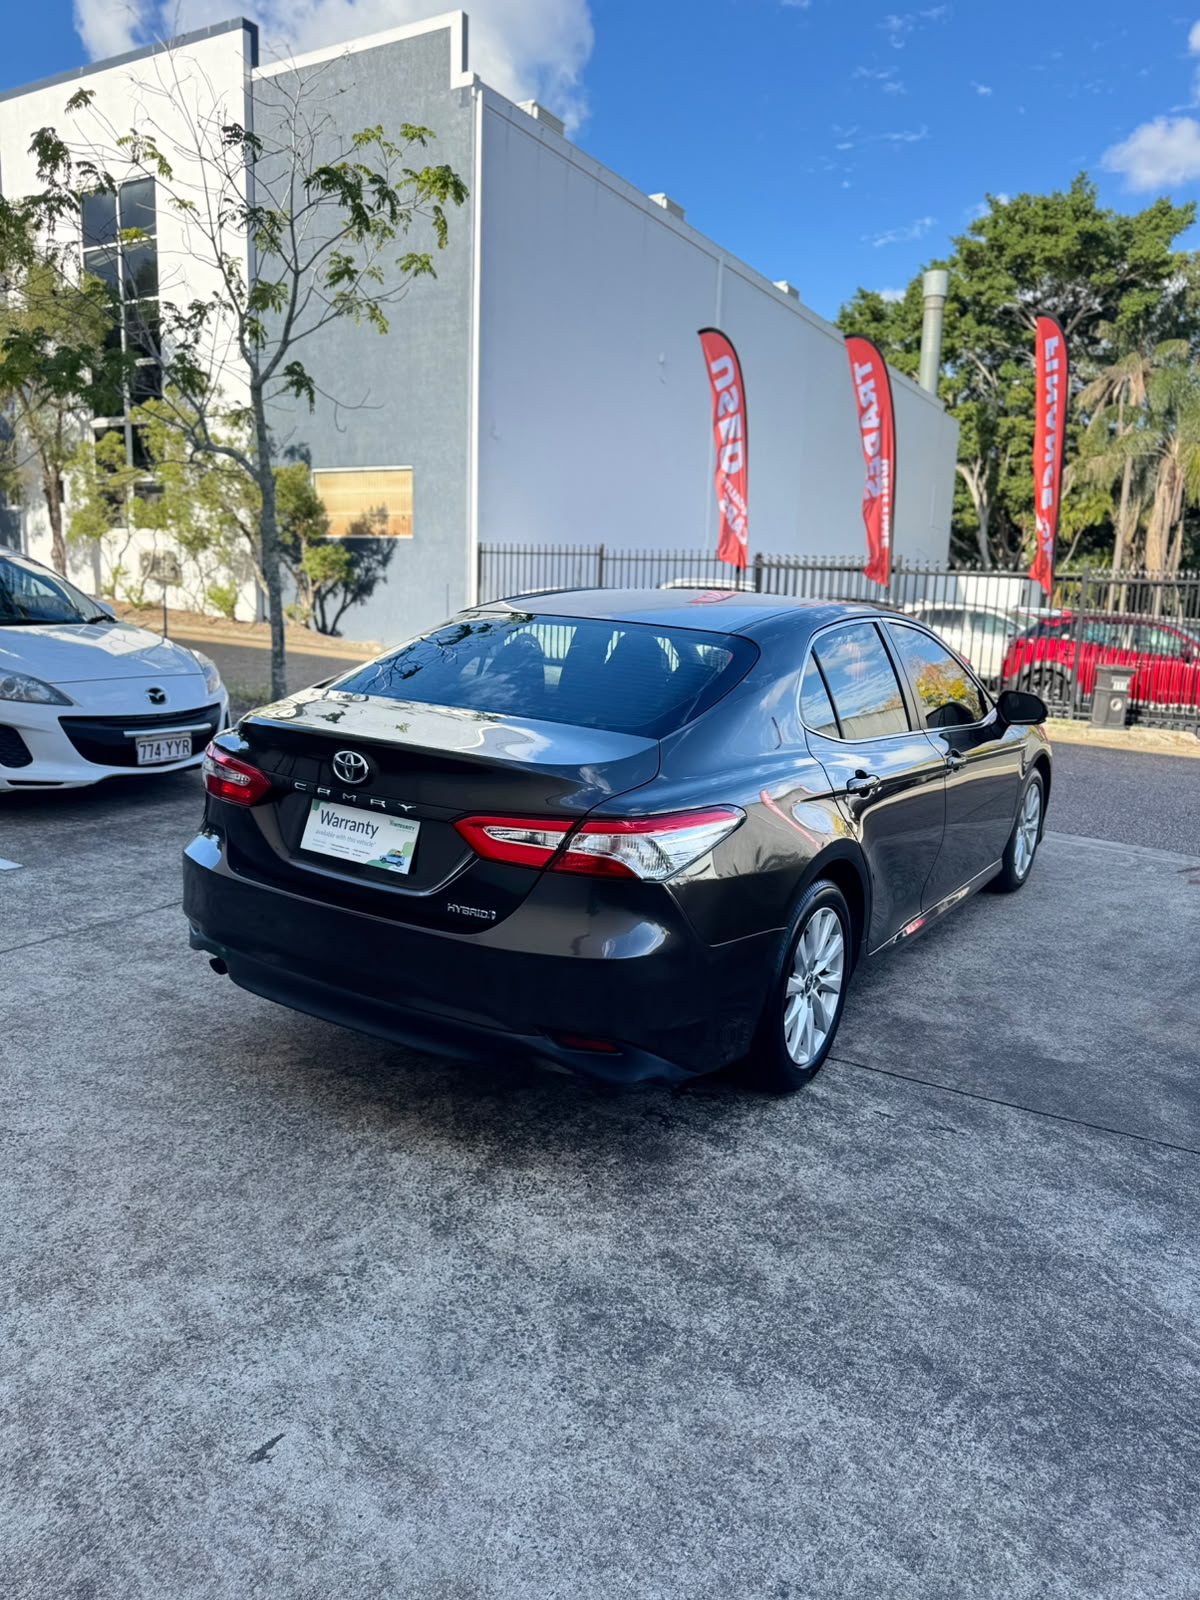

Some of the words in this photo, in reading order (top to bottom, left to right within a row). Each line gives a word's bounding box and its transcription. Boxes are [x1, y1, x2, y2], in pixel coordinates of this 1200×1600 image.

[140, 743, 161, 759] 774
[166, 739, 190, 755] YYR
[294, 782, 416, 812] CAMRY
[320, 809, 379, 839] Warranty
[447, 903, 488, 919] HYBRID
